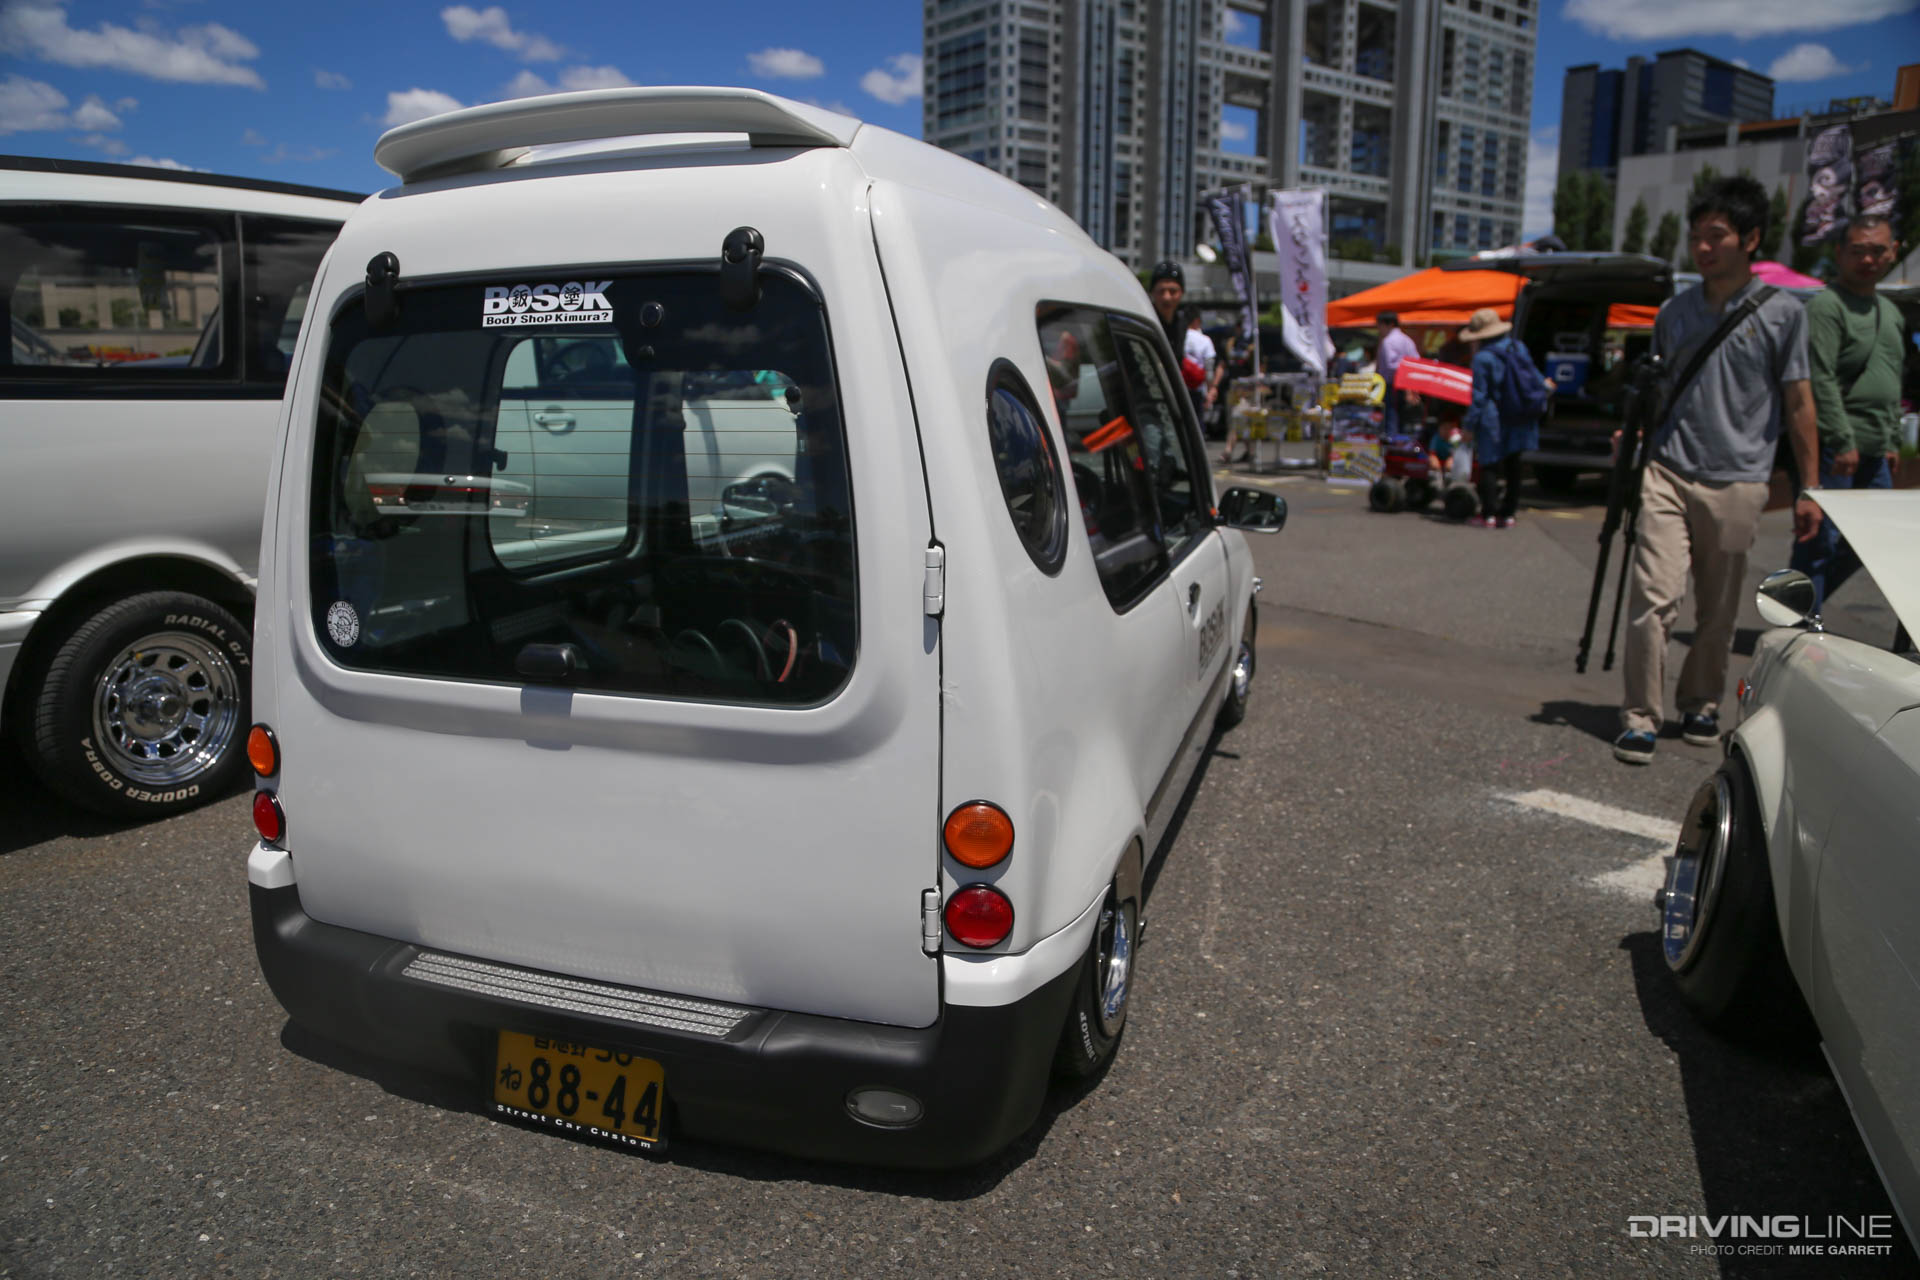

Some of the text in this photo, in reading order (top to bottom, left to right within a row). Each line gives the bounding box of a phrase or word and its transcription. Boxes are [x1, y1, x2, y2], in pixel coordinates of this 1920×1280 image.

[483, 280, 614, 315] BOSOK
[486, 315, 517, 325] Body
[555, 312, 609, 322] Kimura?
[164, 614, 226, 640] RADIAL
[81, 737, 200, 802] COOPER COBRA
[500, 1057, 659, 1138] ね 88-44
[497, 1104, 651, 1149] Street Car Custom
